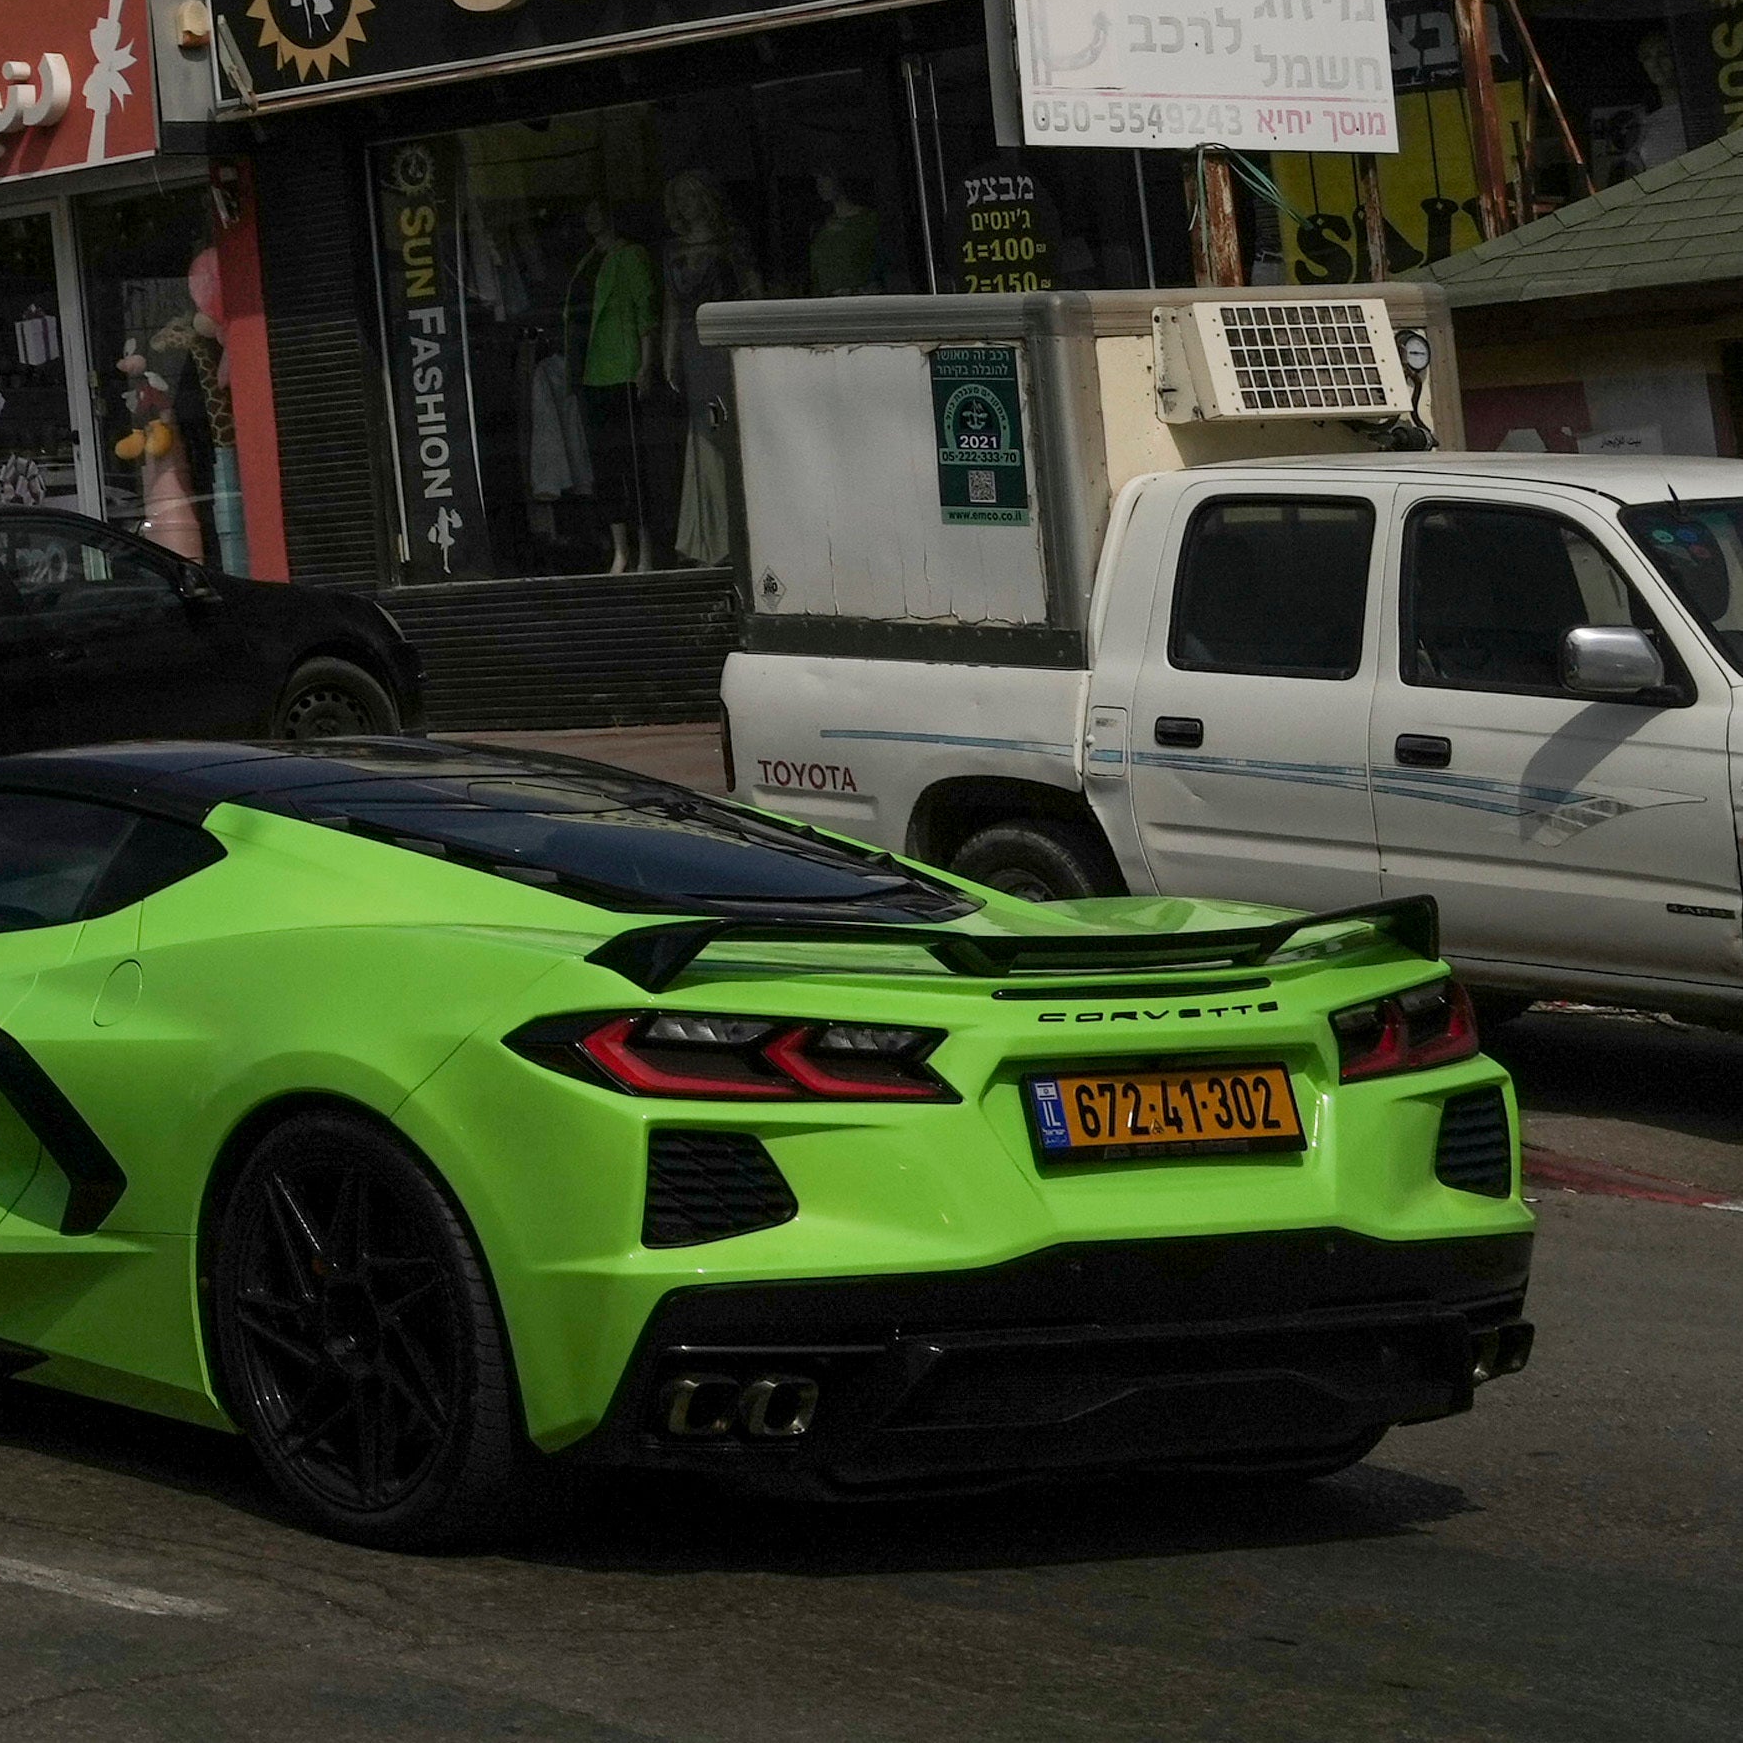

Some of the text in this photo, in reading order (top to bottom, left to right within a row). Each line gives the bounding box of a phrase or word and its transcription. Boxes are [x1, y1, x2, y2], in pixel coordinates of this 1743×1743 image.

[1128, 7, 1243, 55] לרכב
[1253, 44, 1383, 91] חשמל
[1033, 100, 1388, 143] מוסך יחיא 050-5549243
[965, 175, 1034, 207] מבצע
[971, 208, 1031, 231] ג'ינסים
[401, 205, 454, 499] SUN FASHION
[973, 350, 987, 361] זה
[989, 350, 1010, 361] רכב
[972, 364, 1008, 376] להובלה
[960, 435, 997, 449] 2021
[949, 509, 1022, 522] www.emco.co.il
[757, 759, 858, 793] TOYOTA
[1037, 1000, 1279, 1024] CORVETTE
[1043, 1100, 1062, 1126] IL
